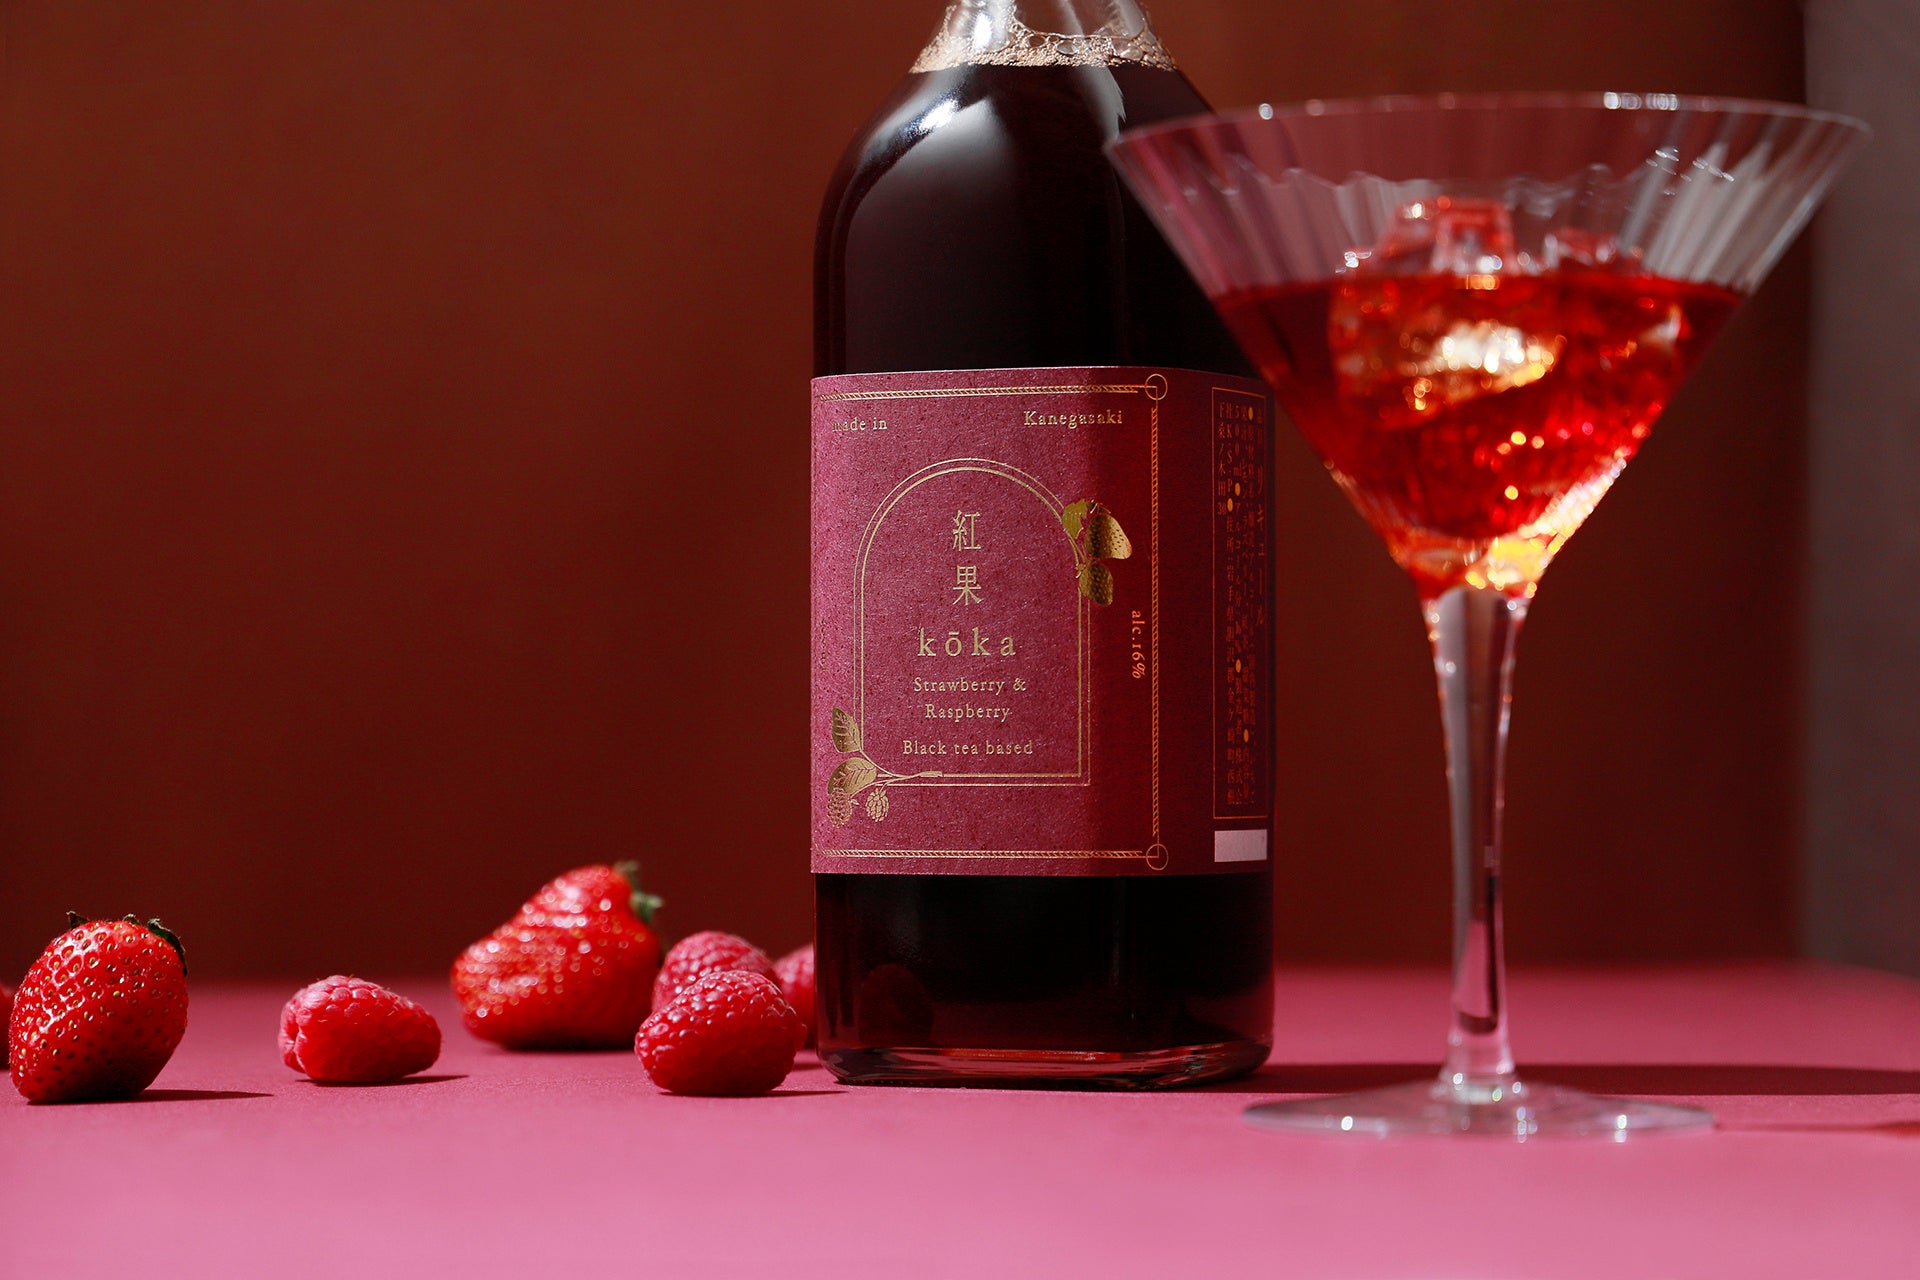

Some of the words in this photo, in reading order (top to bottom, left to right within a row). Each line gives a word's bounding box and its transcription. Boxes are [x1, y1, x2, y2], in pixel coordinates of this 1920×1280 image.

[872, 416, 888, 431] in
[1023, 409, 1123, 430] Kanegasaki
[952, 510, 984, 607] 紅果
[917, 626, 1016, 657] kōka
[1131, 610, 1146, 679] alc.16%
[913, 676, 1005, 696] Strawberry
[1012, 677, 1027, 691] &
[925, 703, 1010, 723] Raspberry
[903, 739, 947, 755] Black
[953, 742, 979, 755] tea
[985, 739, 1033, 755] based
